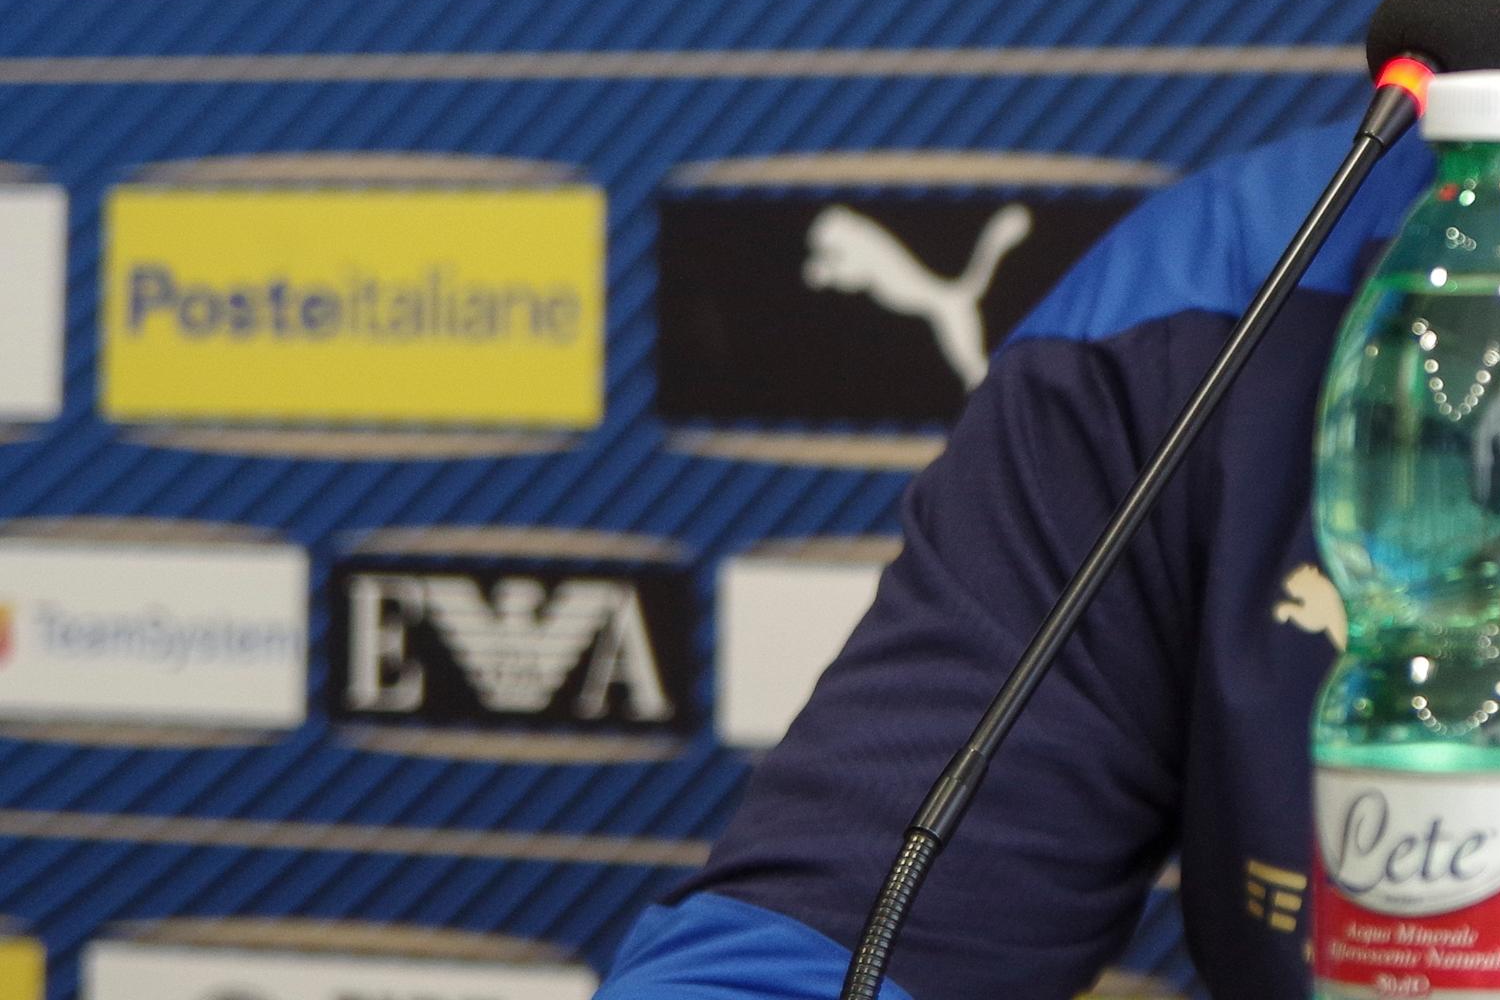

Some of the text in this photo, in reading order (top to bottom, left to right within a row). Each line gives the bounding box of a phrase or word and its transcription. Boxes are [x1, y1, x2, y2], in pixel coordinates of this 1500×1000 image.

[1336, 789, 1486, 894] Lete
[1347, 920, 1479, 947] Acqua Minerale
